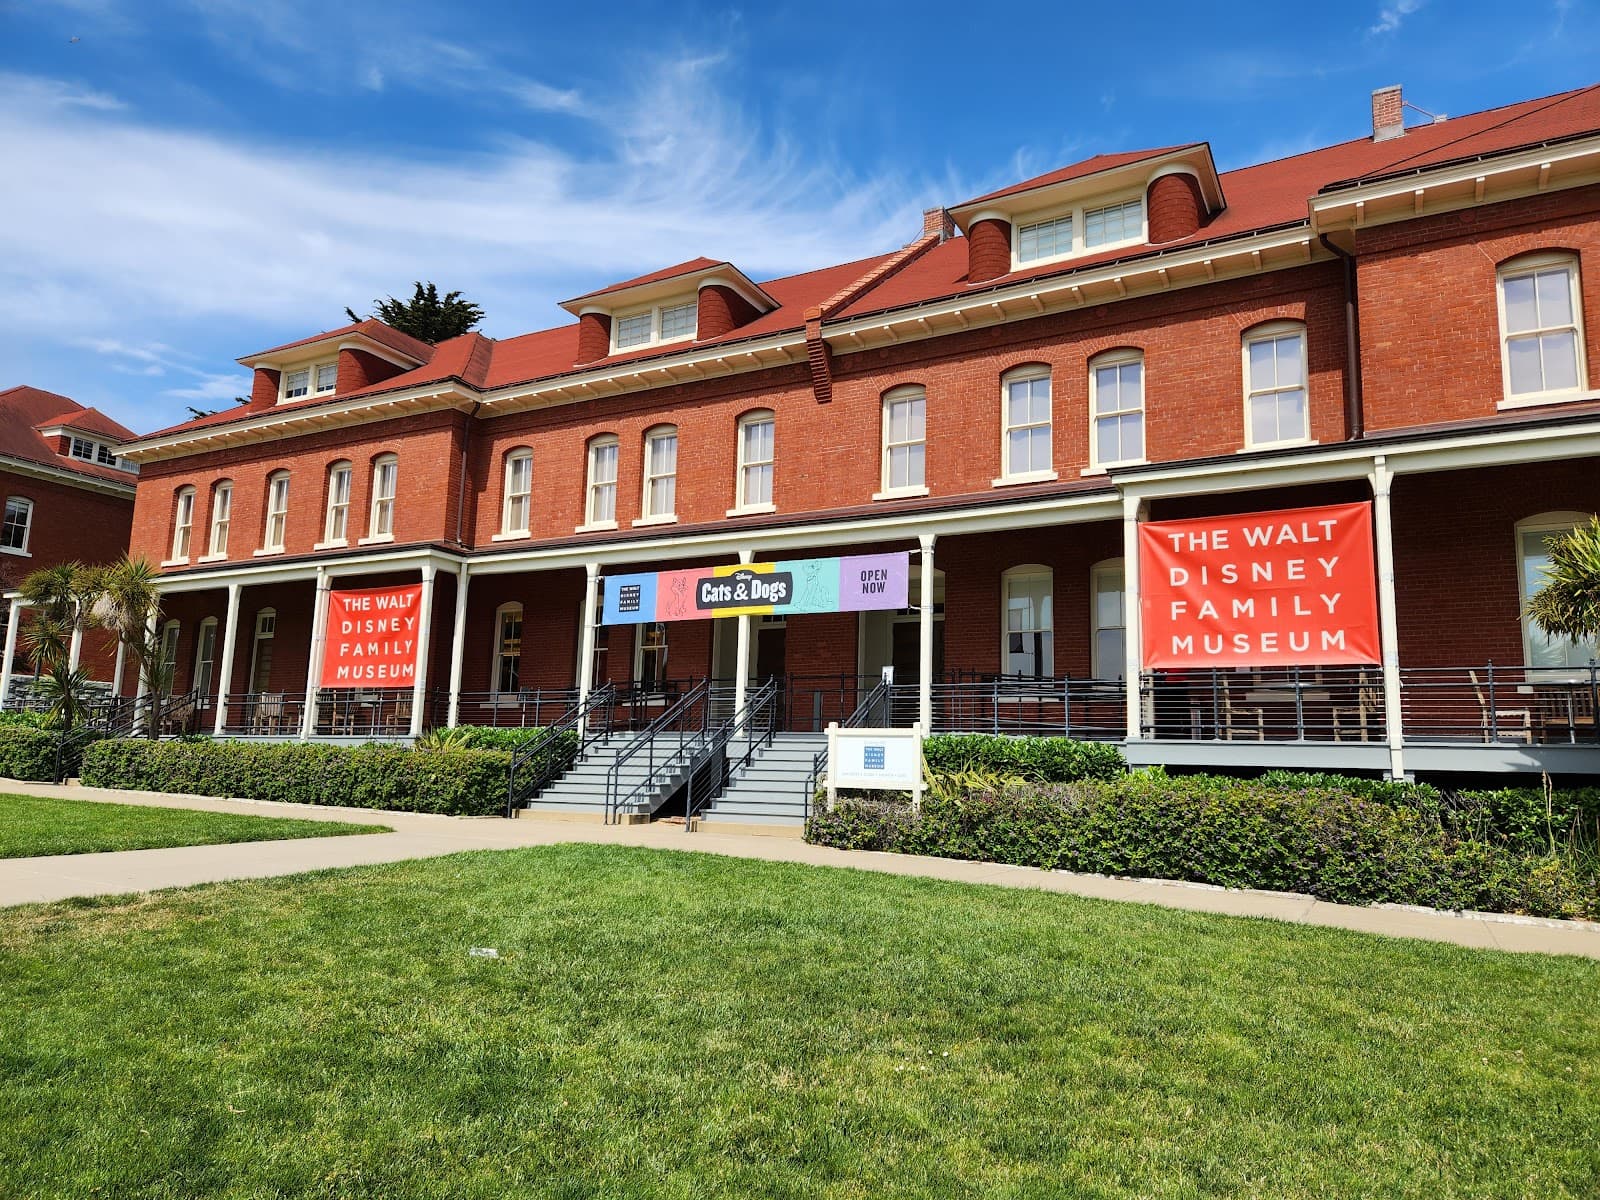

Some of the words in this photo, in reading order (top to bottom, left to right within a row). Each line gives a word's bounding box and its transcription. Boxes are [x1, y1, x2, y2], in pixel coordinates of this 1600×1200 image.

[1168, 529, 1230, 553] THE
[1242, 519, 1338, 548] WALT
[734, 572, 753, 582] Disney
[860, 568, 888, 582] OPEN
[1169, 555, 1340, 587] DISNEY
[701, 582, 732, 603] Cats
[733, 582, 749, 601] &
[751, 579, 787, 603] Dogs
[862, 581, 886, 594] NOW
[343, 597, 371, 612] THE
[376, 593, 414, 610] WALT
[1170, 592, 1342, 621] FAMILY
[341, 616, 415, 635] DISNEY
[340, 639, 413, 657] FAMILY
[1171, 629, 1346, 656] MUSEUM
[336, 663, 414, 680] MUSEUM
